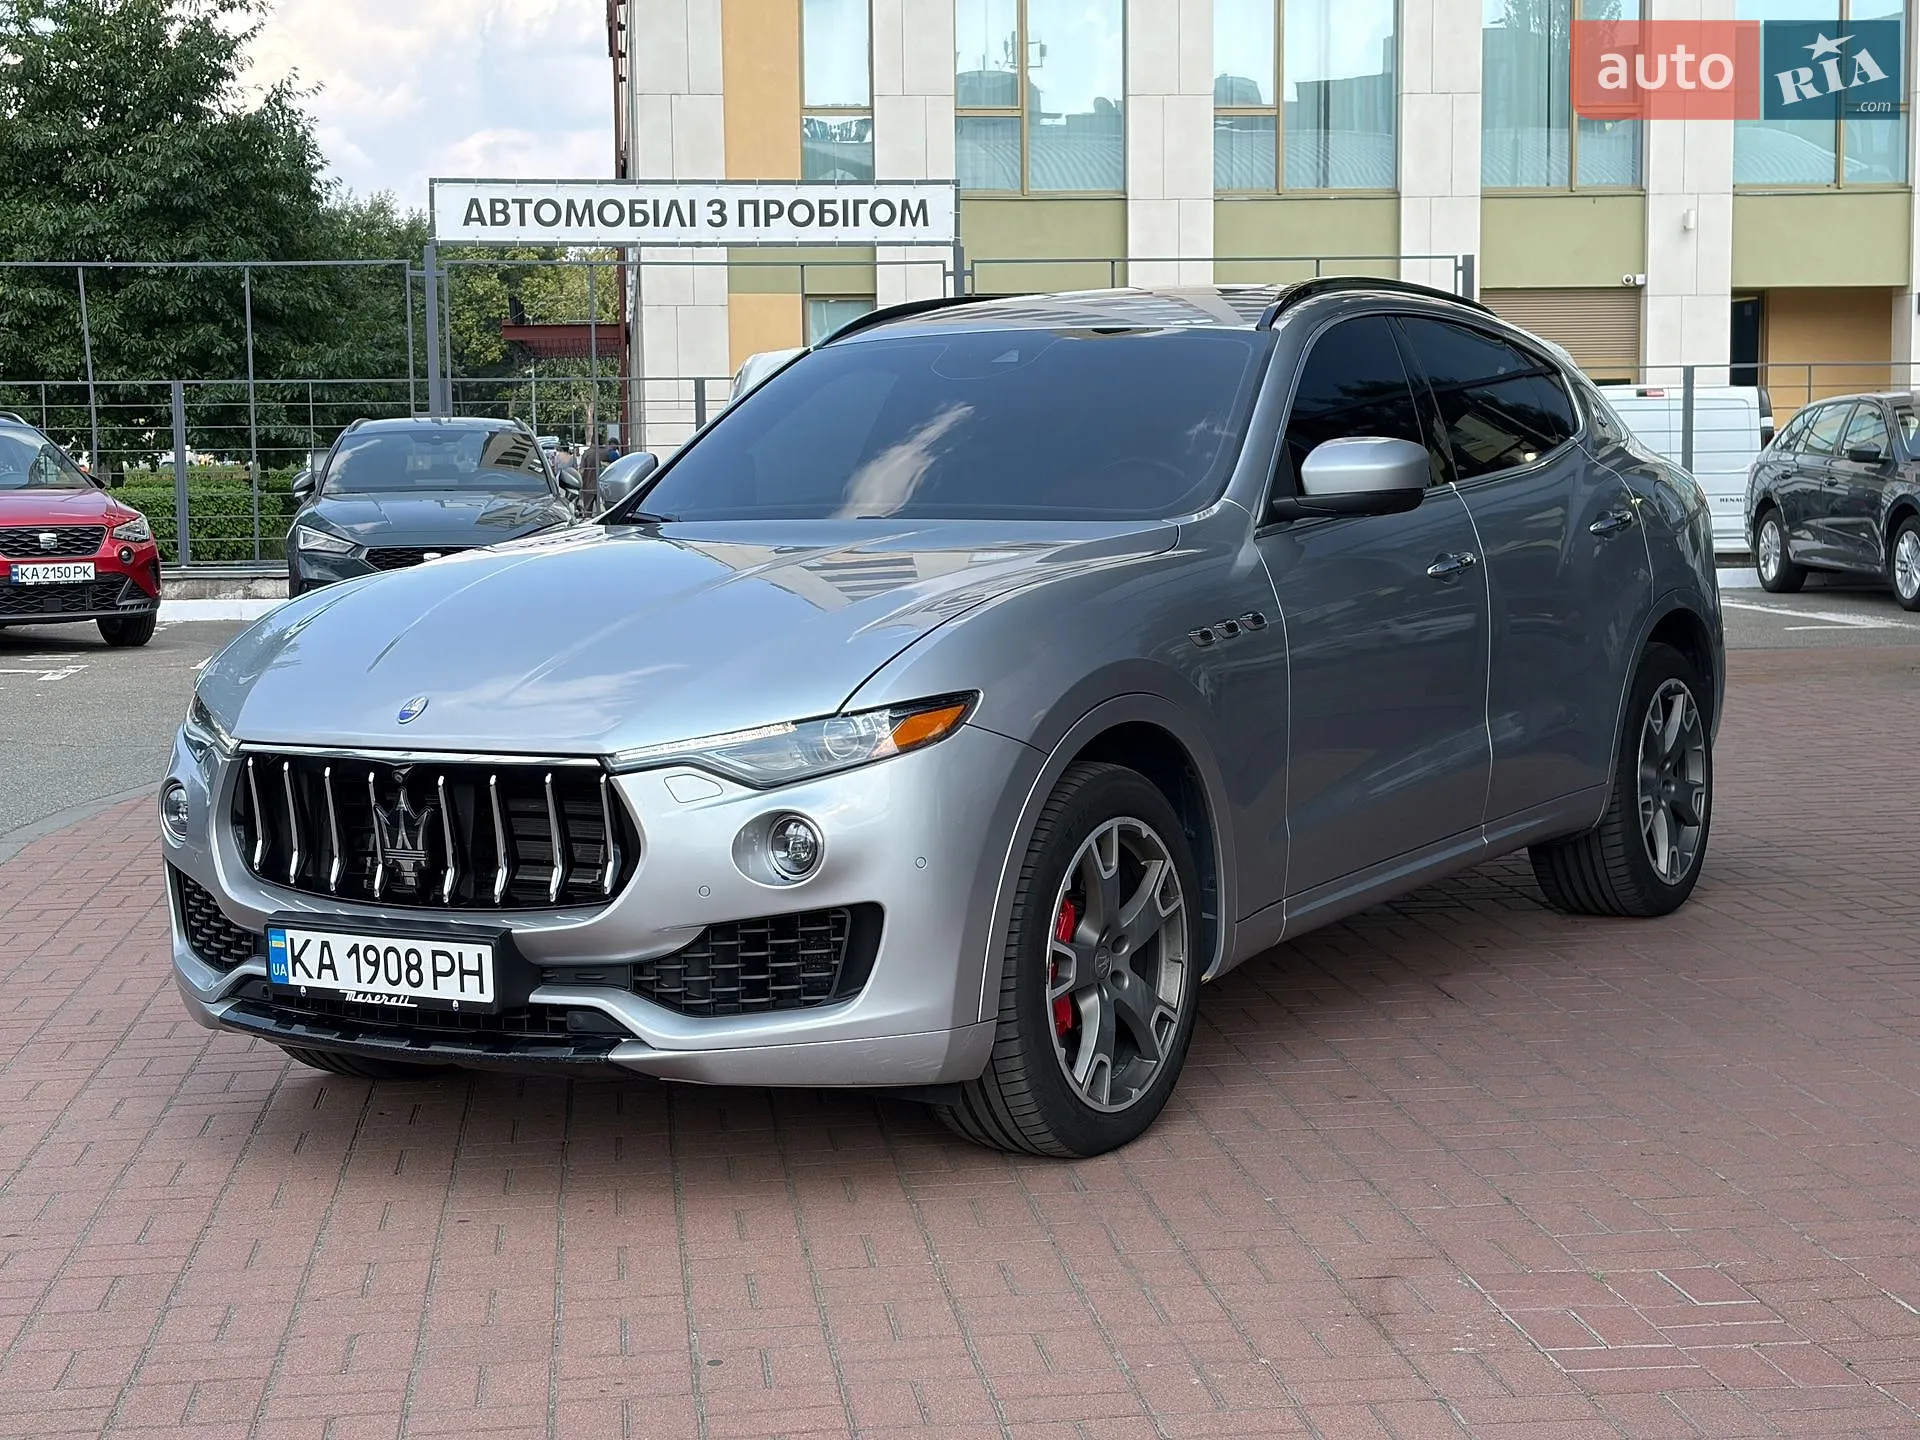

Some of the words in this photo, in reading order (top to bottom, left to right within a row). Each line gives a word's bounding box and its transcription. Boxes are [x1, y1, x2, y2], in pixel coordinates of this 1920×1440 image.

[462, 197, 697, 228] АВТОМОБІЛІ
[705, 198, 728, 228] З
[737, 198, 930, 228] ПРОБІГОМ
[20, 567, 40, 580] KA
[42, 566, 71, 579] 2150
[73, 565, 92, 578] PK
[272, 962, 288, 977] UA
[289, 936, 340, 982] KA
[345, 942, 424, 989] 1908
[430, 948, 486, 995] PH
[339, 989, 418, 1009] Maserati
